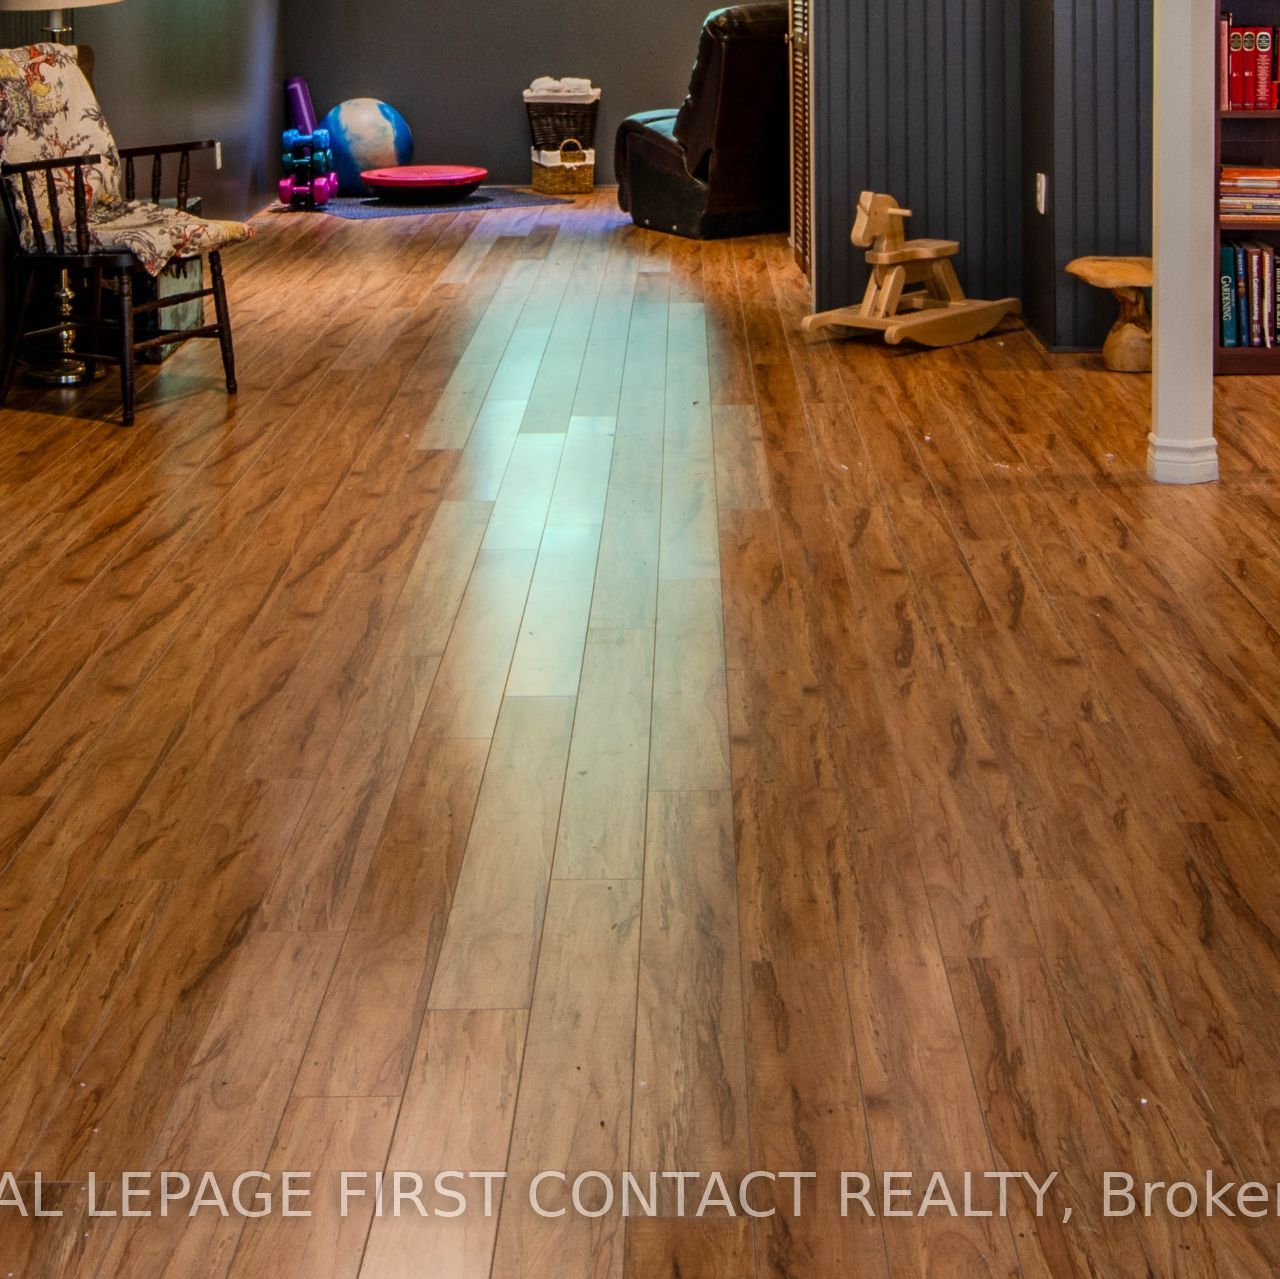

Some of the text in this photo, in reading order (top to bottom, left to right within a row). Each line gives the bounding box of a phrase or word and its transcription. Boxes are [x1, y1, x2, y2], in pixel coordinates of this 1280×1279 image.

[1220, 275, 1232, 321] GARDENING
[1251, 255, 1260, 321] Modern Cabinetmaking
